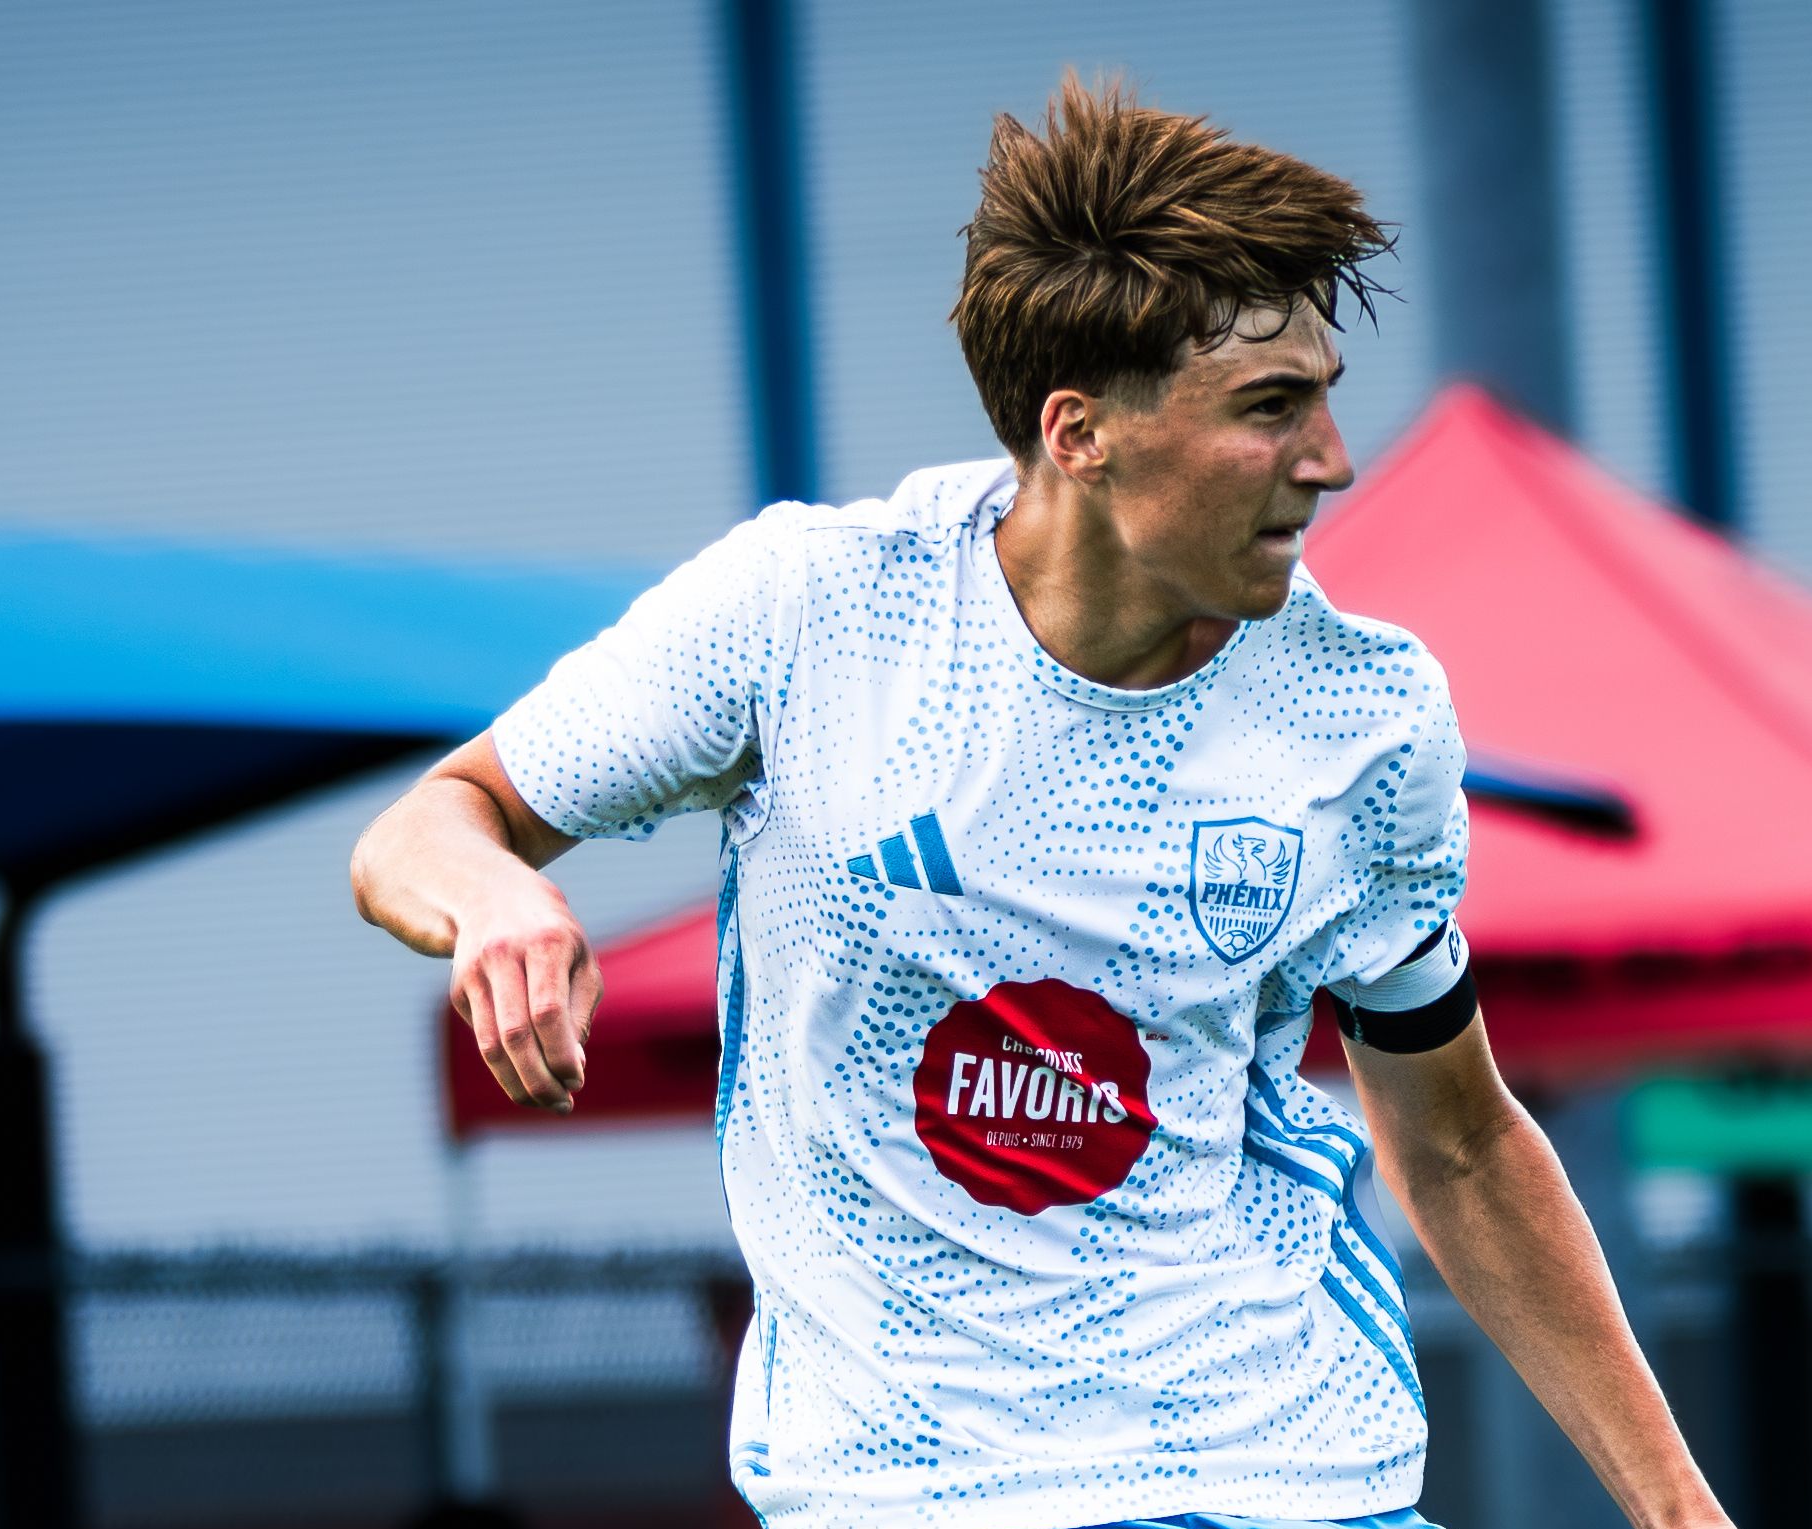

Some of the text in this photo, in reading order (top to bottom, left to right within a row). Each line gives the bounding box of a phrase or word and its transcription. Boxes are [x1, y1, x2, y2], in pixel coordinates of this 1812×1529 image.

[1200, 879, 1285, 911] PHÉNIX
[947, 1052, 1128, 1124] FAVORIS
[986, 1130, 1083, 1150] DEPUIS SINCE 1979
